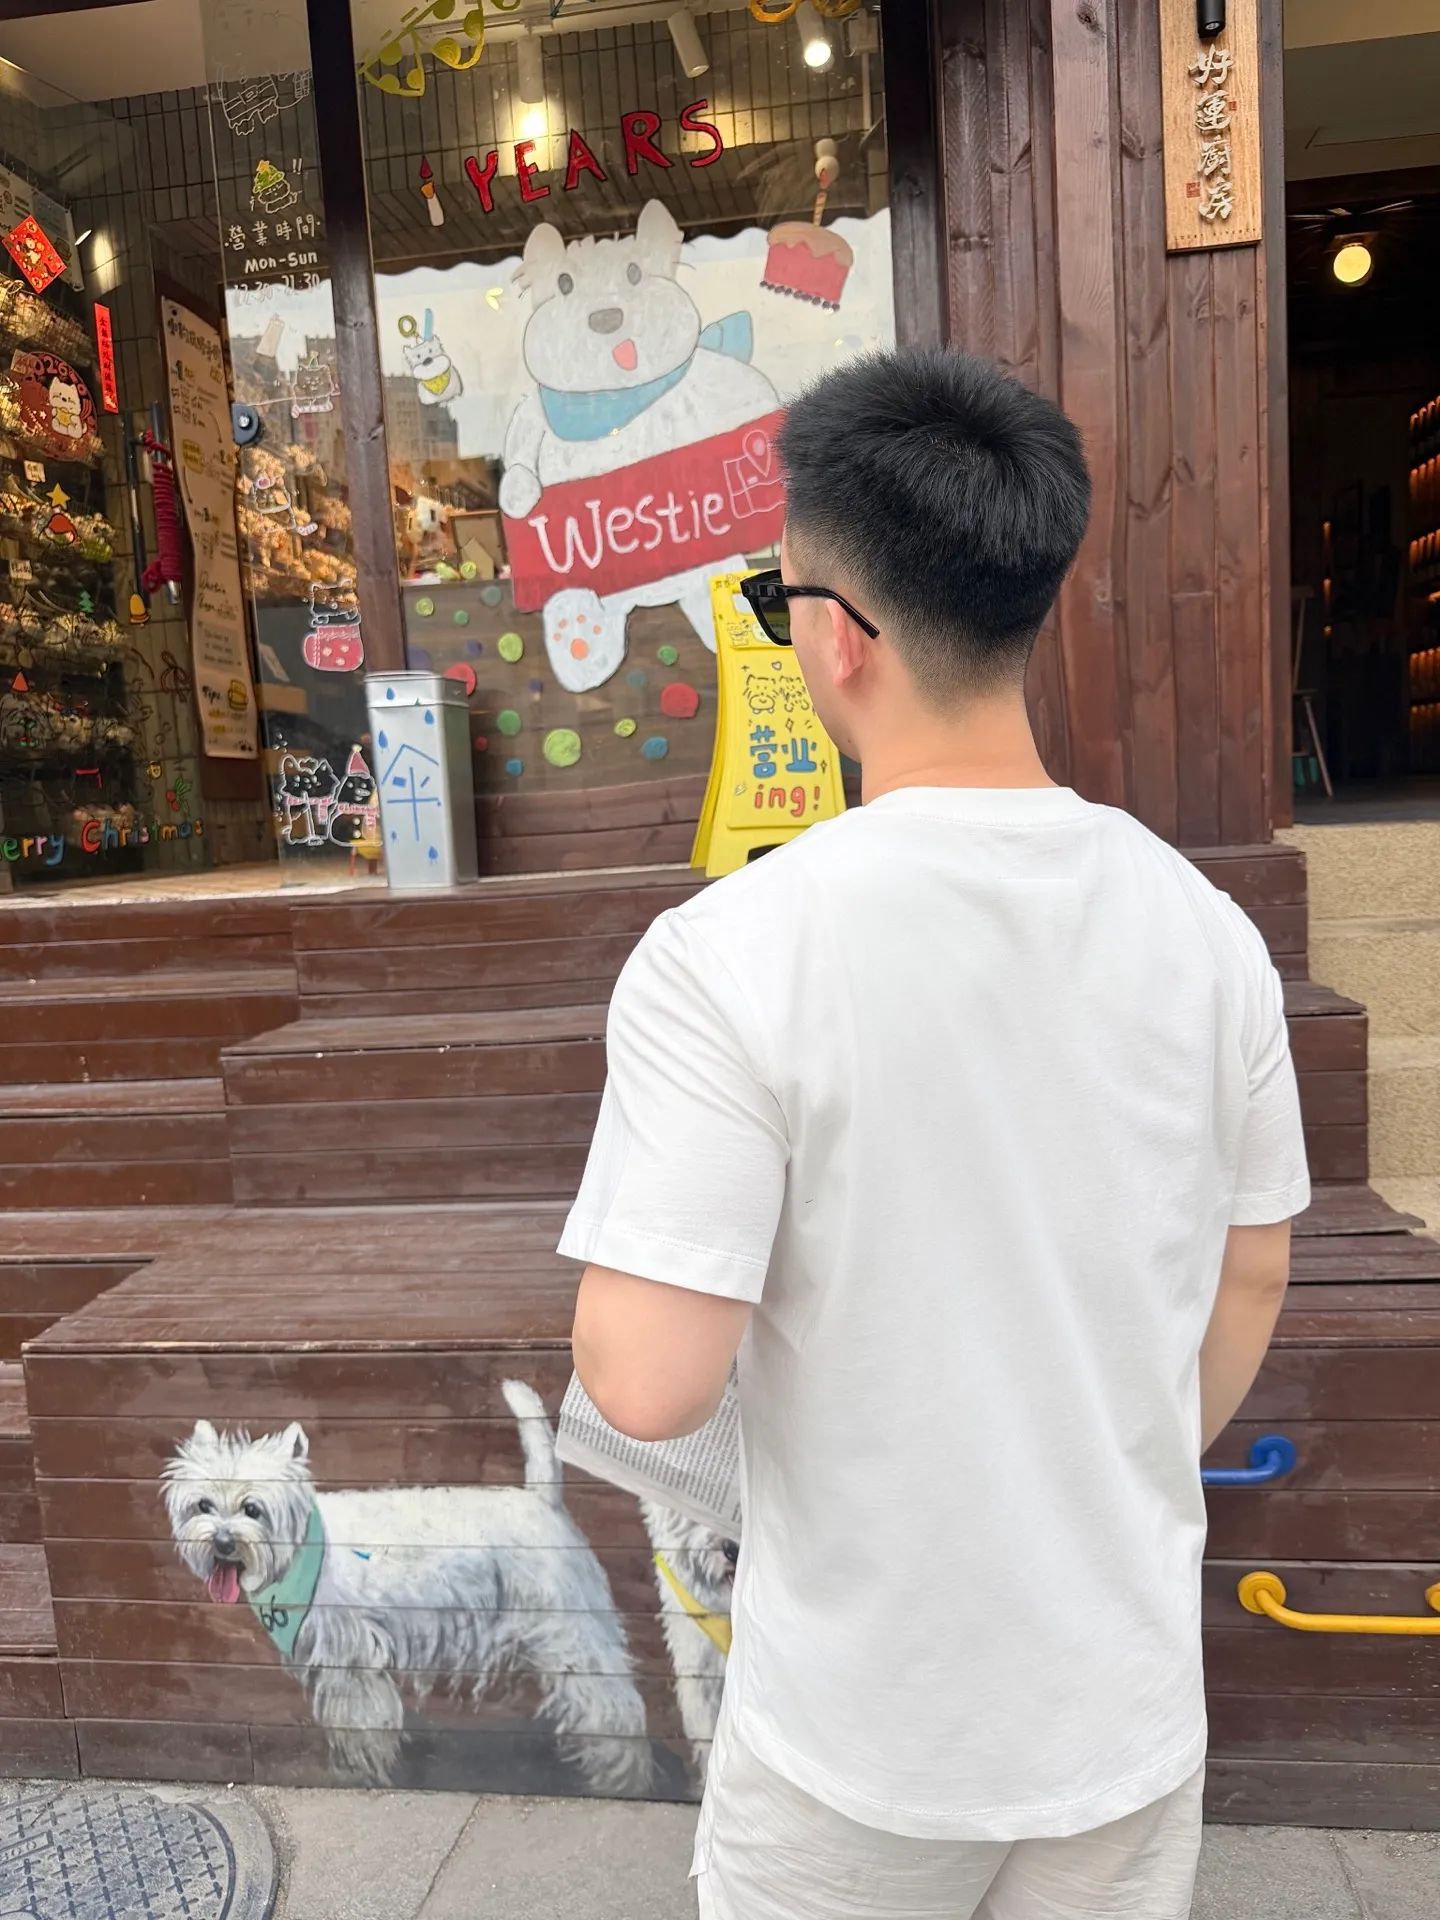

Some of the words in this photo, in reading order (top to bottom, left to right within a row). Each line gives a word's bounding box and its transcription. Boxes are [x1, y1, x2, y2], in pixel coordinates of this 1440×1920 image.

[465, 99, 725, 214] YEARS
[228, 214, 315, 251] 營業時間
[244, 251, 318, 274] Mon-Sun
[527, 490, 732, 574] Westie
[750, 724, 817, 779] 营业
[381, 743, 440, 842] 伞
[754, 783, 820, 817] ing!
[0, 832, 65, 866] erry
[81, 816, 204, 854] Christmas
